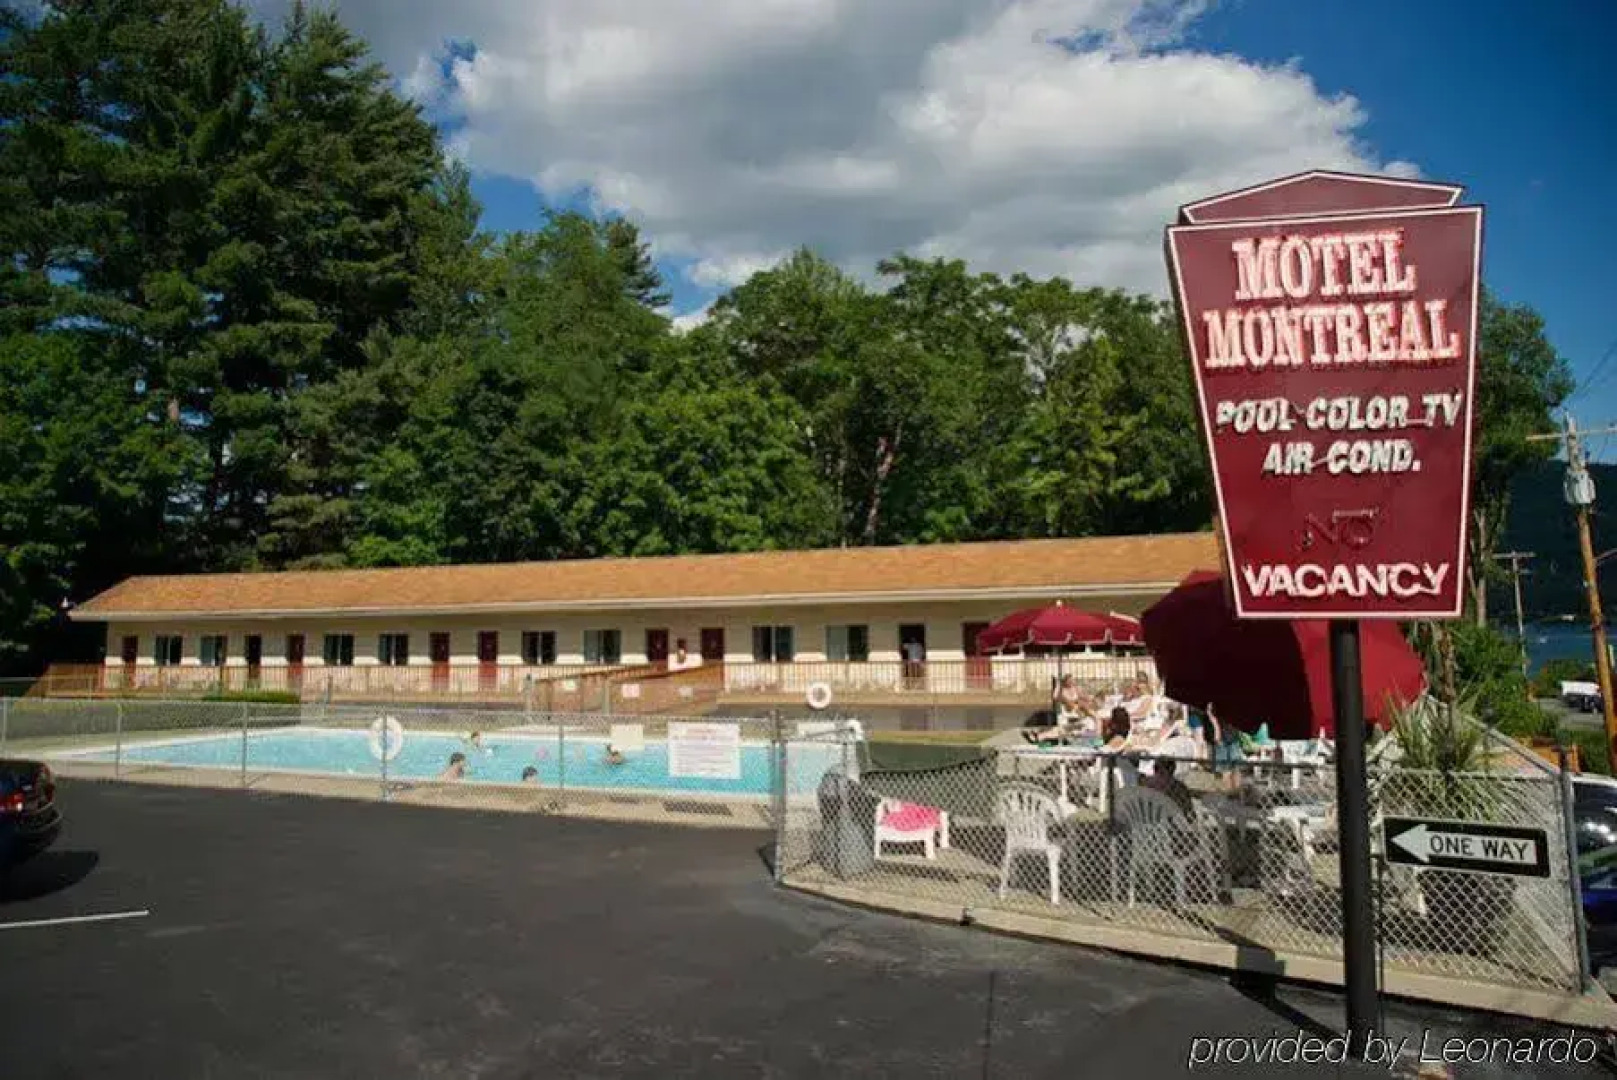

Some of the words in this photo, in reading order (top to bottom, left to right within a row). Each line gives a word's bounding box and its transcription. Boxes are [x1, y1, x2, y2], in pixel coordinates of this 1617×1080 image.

[1232, 230, 1416, 300] MOTEL
[1203, 299, 1461, 369] MONTREAL
[1216, 397, 1295, 433] POOL
[1306, 395, 1409, 430] COLOR
[1422, 391, 1463, 428] TV
[1262, 441, 1315, 475] AIR
[1326, 438, 1421, 474] COND.
[1242, 561, 1449, 597] VACANCY
[1430, 834, 1473, 857] ONE
[1481, 838, 1528, 861] WAY
